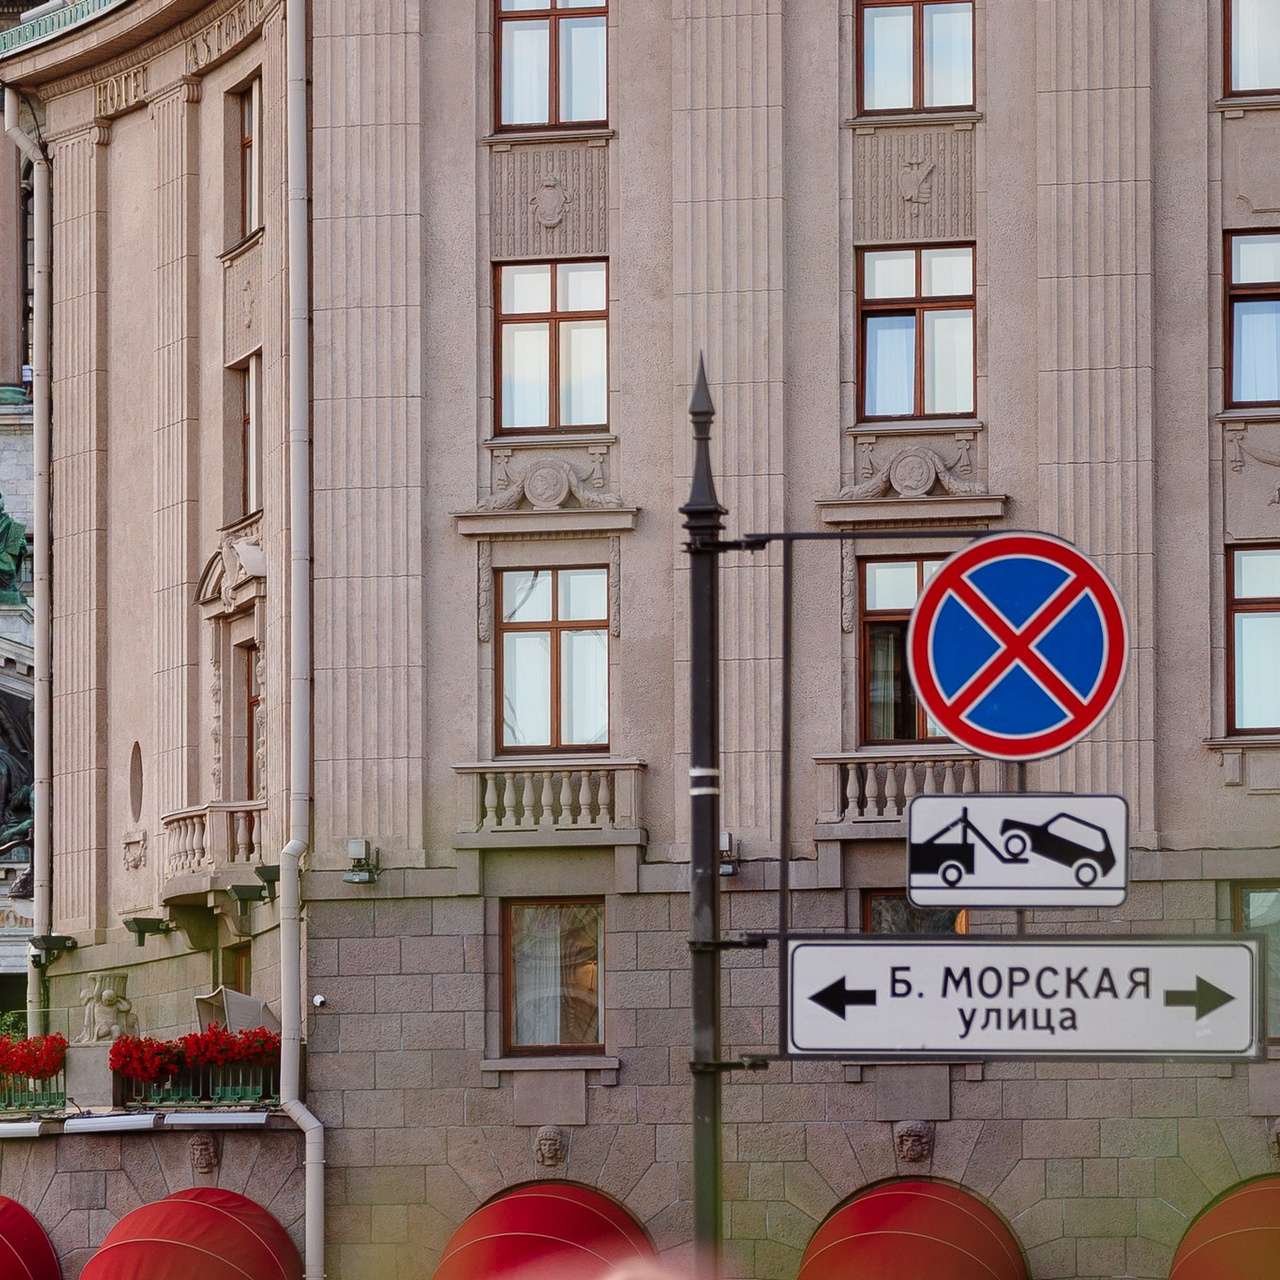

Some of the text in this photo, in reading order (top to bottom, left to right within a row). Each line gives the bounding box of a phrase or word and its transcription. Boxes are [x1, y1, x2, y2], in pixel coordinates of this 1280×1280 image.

[890, 966, 1151, 1000] Б. МОРСКАЯ
[958, 1007, 1078, 1039] улица
